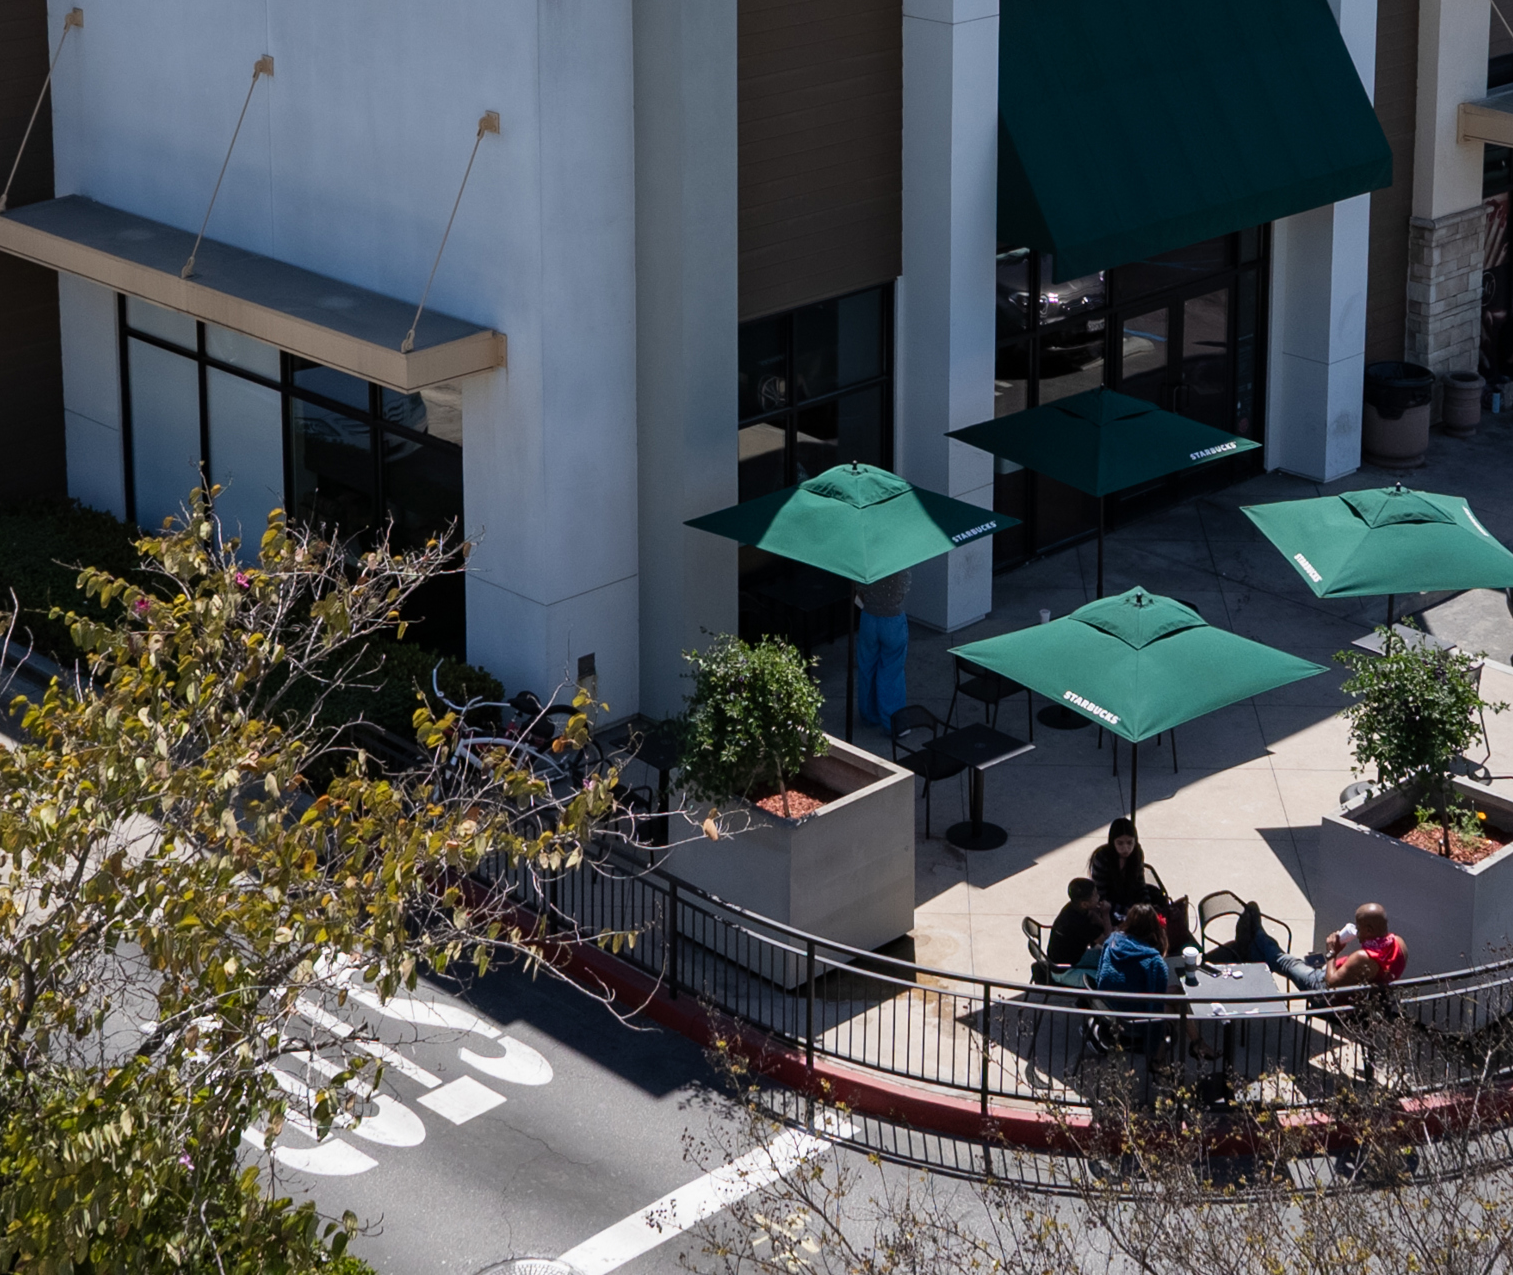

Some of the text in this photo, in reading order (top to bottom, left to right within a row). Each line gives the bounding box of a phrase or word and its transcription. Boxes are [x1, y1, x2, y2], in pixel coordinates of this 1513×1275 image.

[1190, 441, 1237, 461] STARBUCKS
[952, 520, 997, 543] STARBUCKS
[1063, 690, 1120, 725] STARBUCKS
